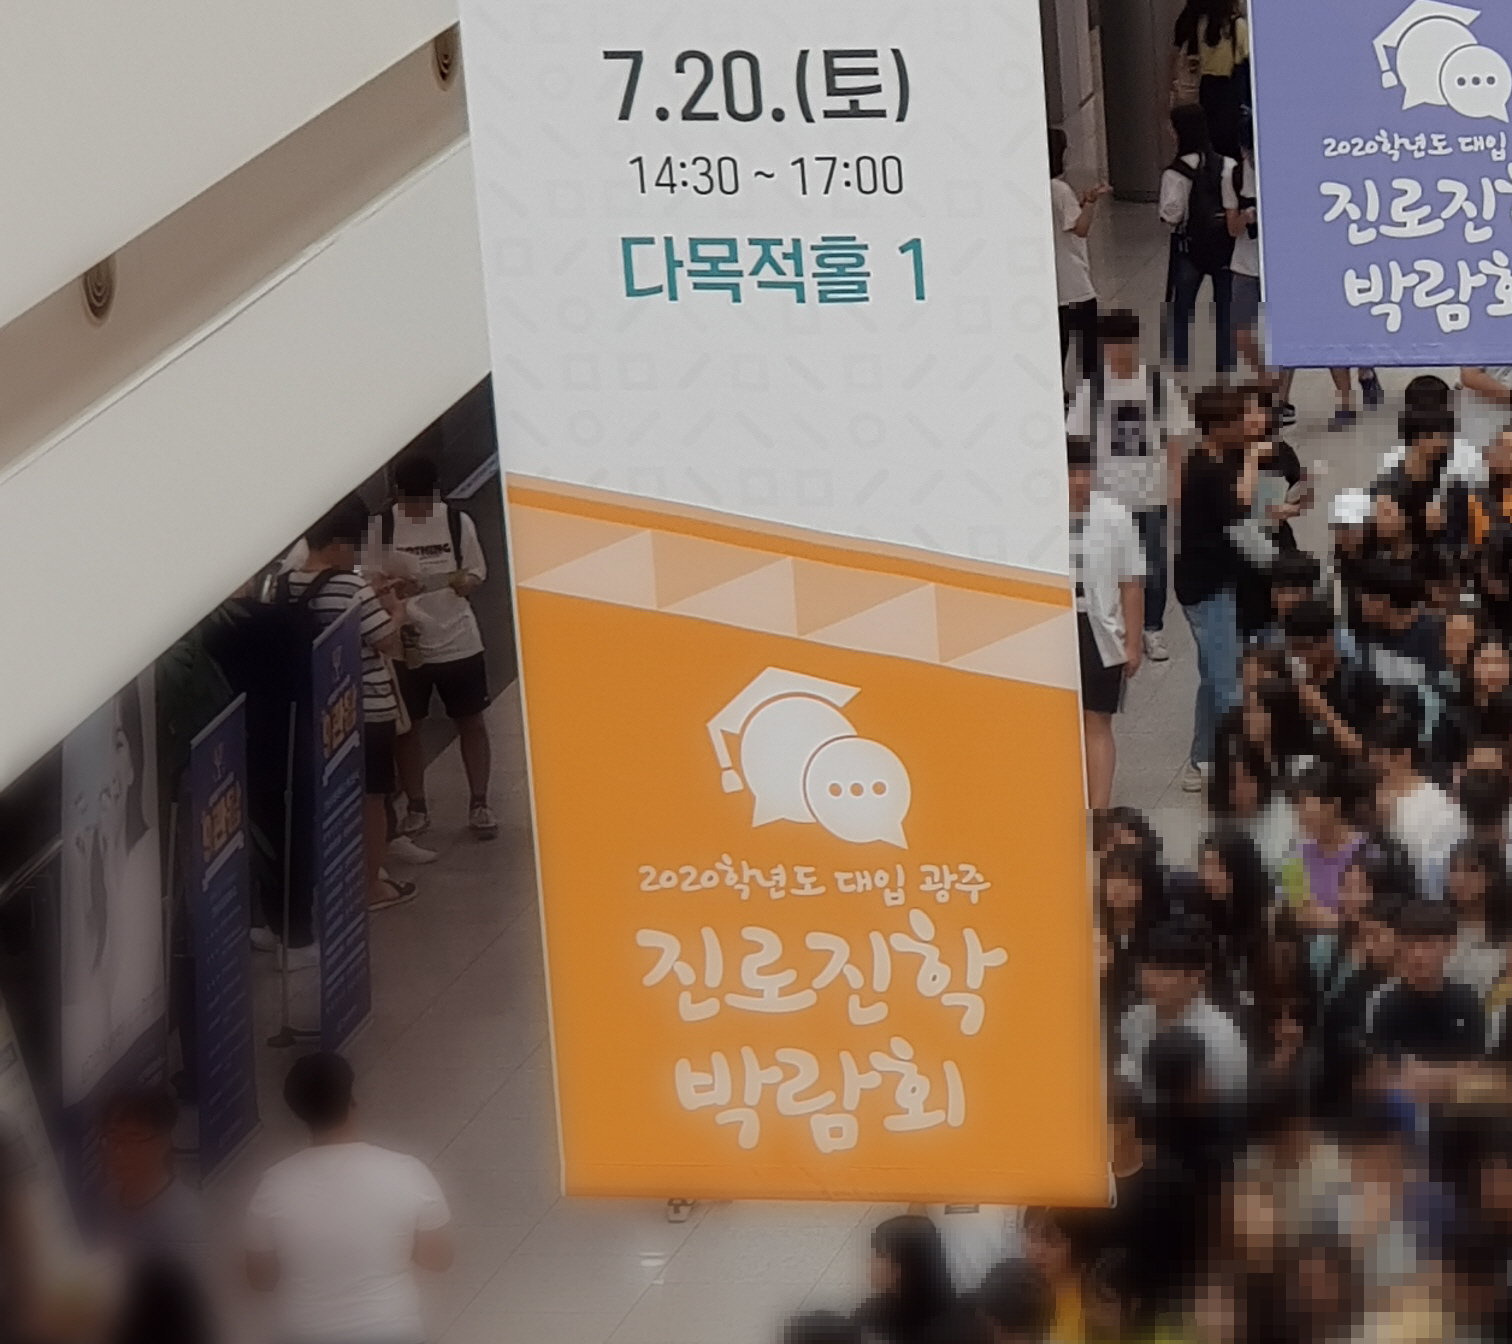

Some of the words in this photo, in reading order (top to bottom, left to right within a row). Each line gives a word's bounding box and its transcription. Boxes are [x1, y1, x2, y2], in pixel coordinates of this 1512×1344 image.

[602, 48, 910, 123] 7.20.(토)
[629, 156, 740, 195] 14:30
[790, 156, 904, 195] 17:00
[1323, 129, 1452, 161] 2020학년도
[1458, 132, 1507, 162] 대입
[621, 236, 871, 304] 다목적홀
[898, 238, 926, 301] 1
[638, 854, 826, 900] 2020학년도
[835, 864, 905, 906] 대입
[919, 863, 991, 904] 광주
[636, 909, 1008, 1036] 진로진학
[675, 1036, 965, 1154] 박람회
